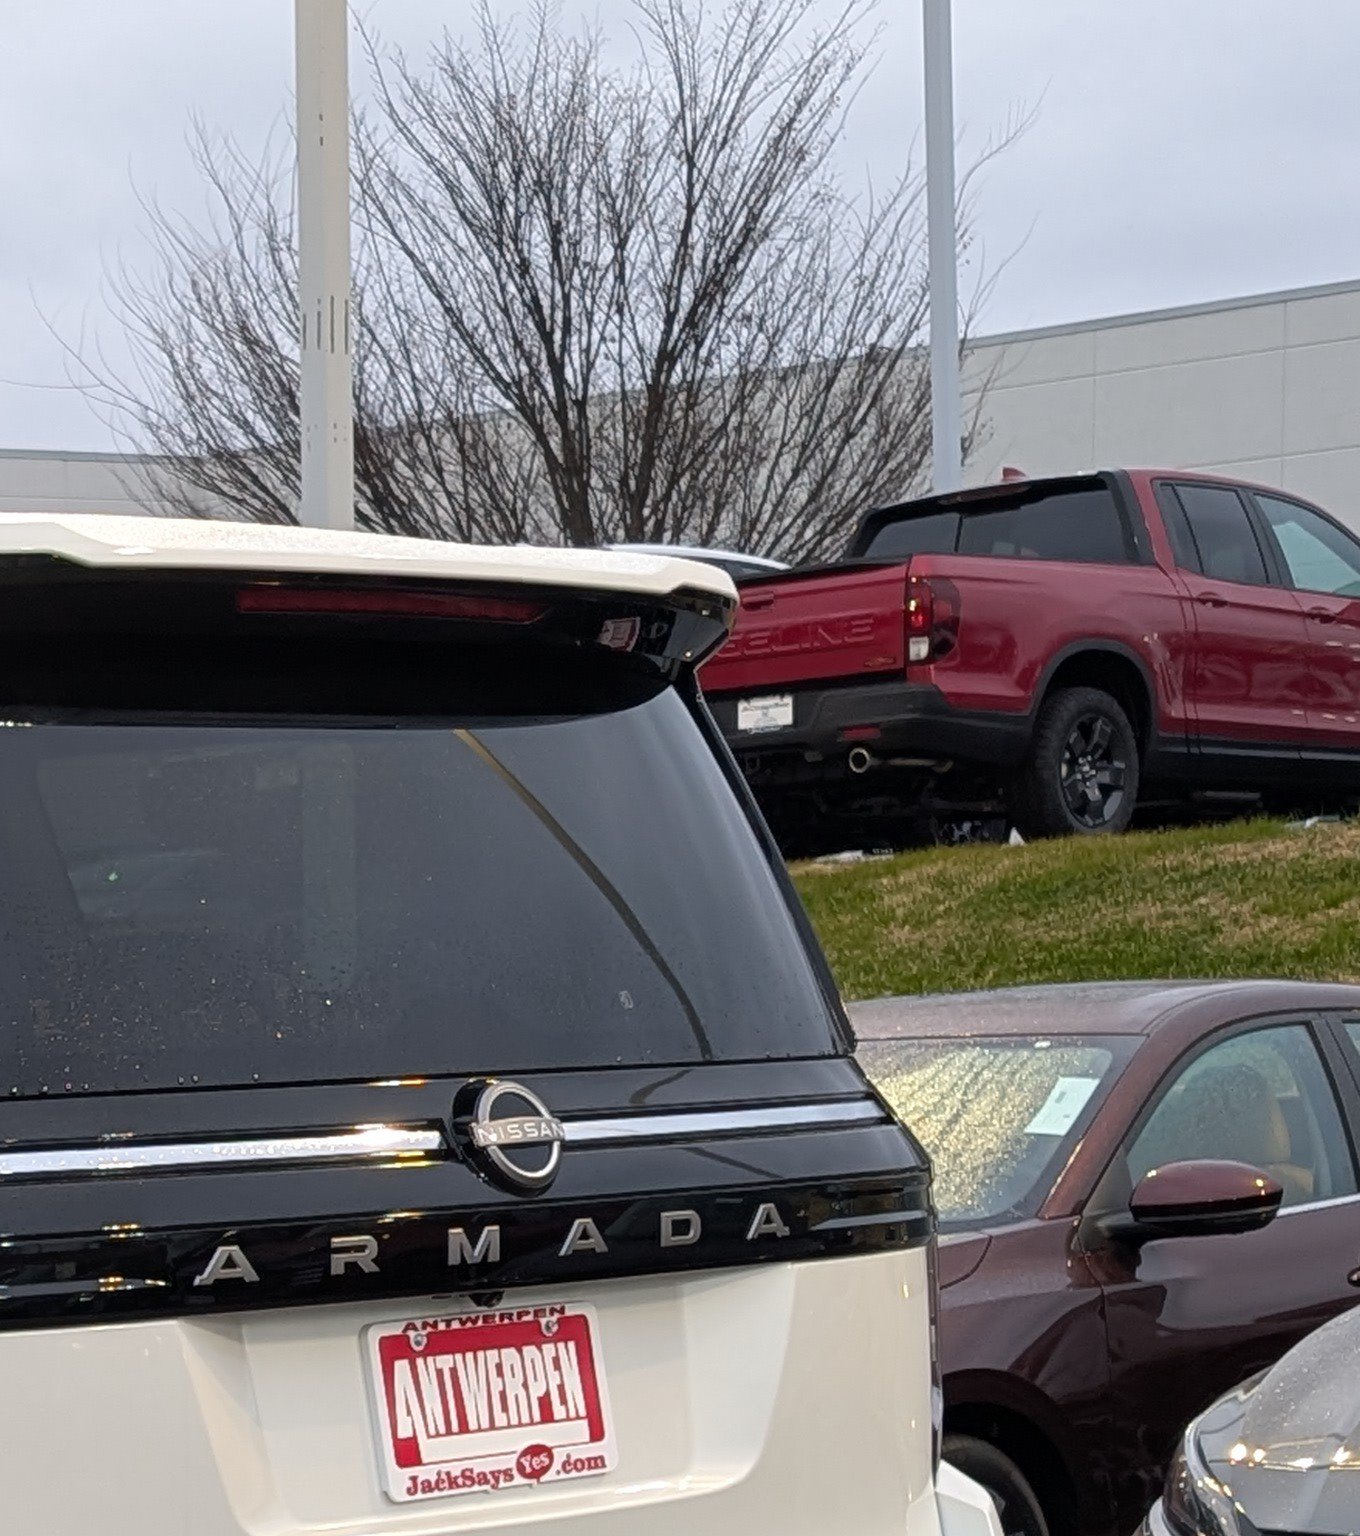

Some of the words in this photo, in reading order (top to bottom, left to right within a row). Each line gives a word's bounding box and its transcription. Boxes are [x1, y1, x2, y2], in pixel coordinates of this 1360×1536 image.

[477, 1121, 565, 1144] NISSAN
[193, 1202, 790, 1286] ARMADA
[401, 1304, 567, 1335] ANTWERPEN
[392, 1340, 588, 1442] ANTWERPEN
